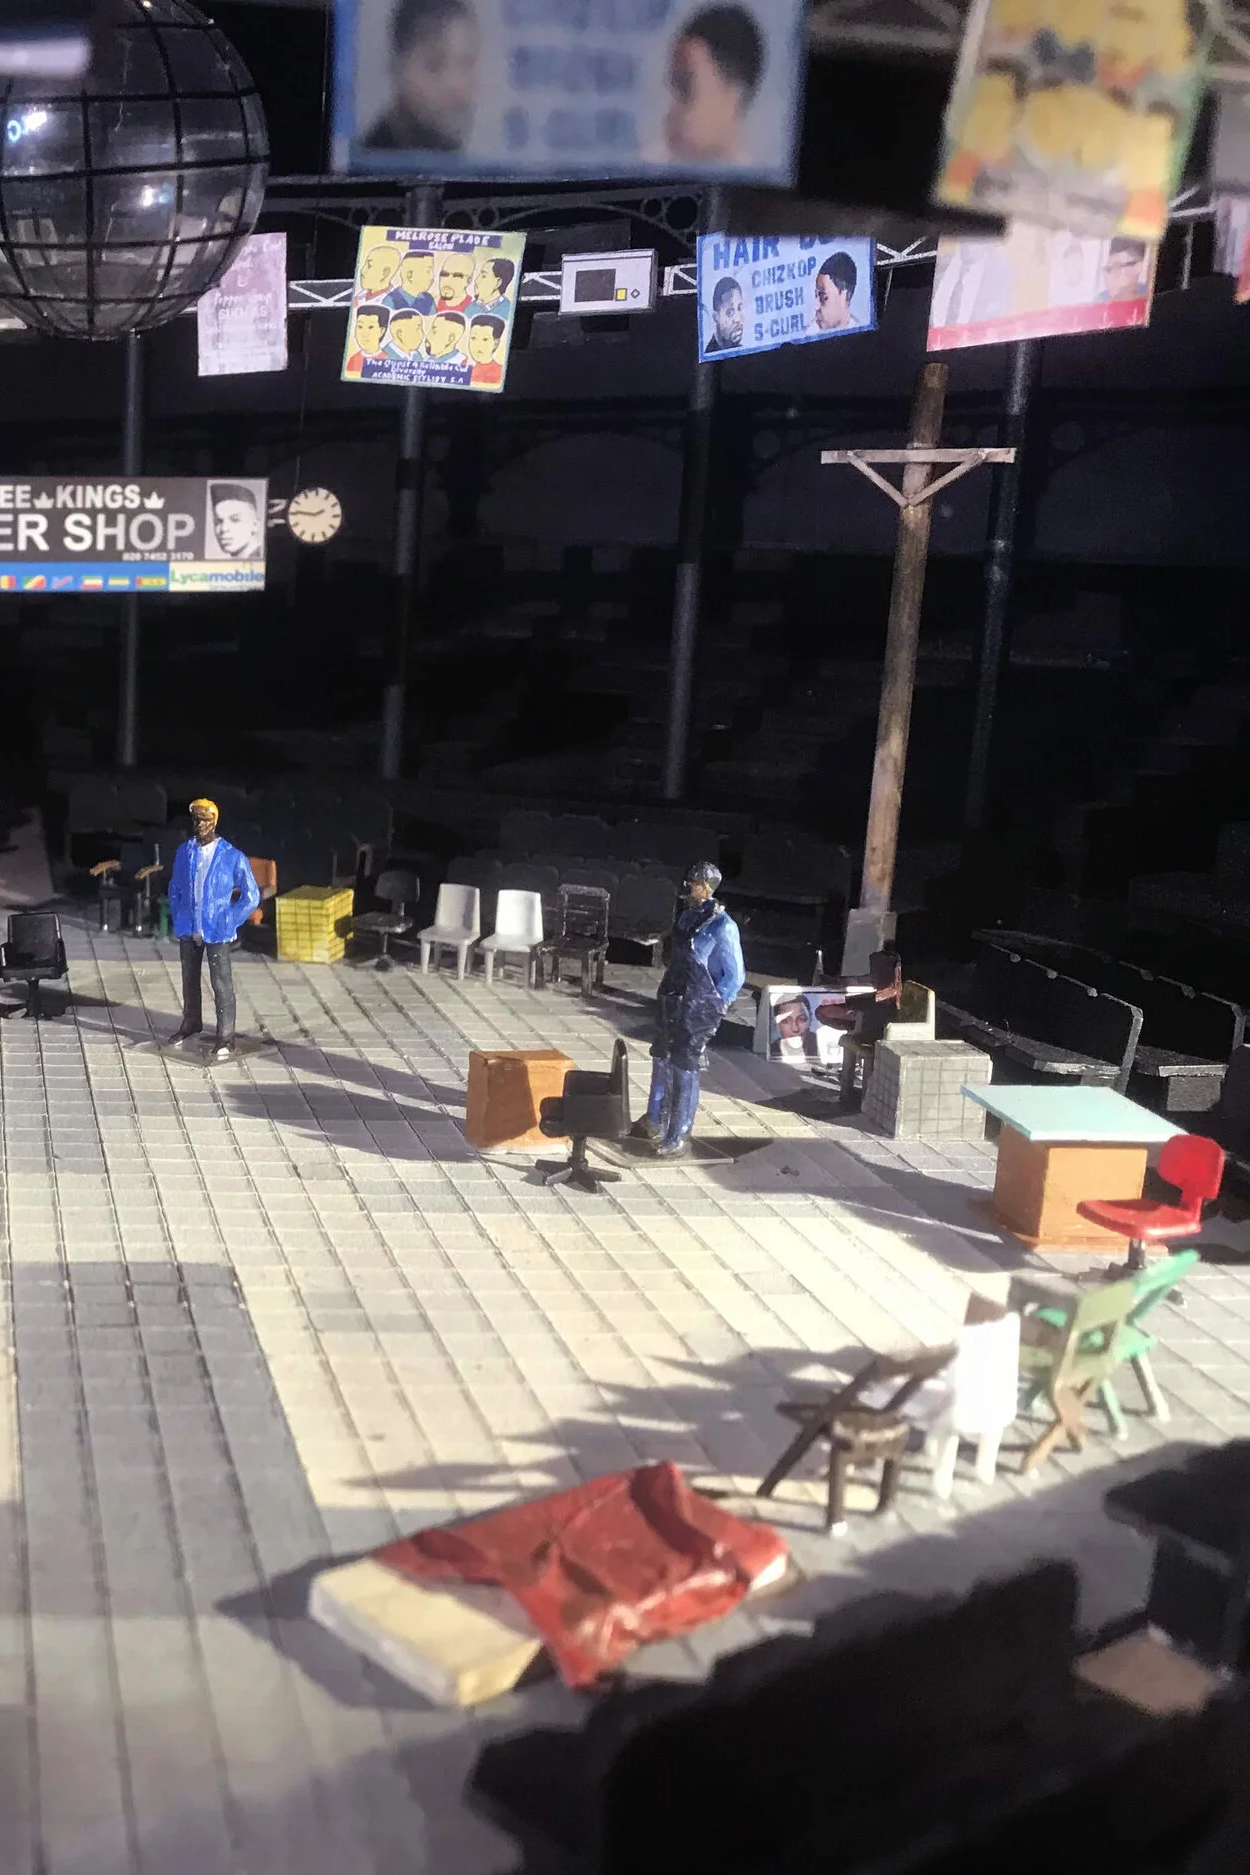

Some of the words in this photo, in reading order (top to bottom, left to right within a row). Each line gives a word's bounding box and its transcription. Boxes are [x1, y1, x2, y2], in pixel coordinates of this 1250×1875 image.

[395, 230, 447, 243] MELROSE
[713, 236, 780, 272] HAIR
[751, 255, 817, 290] CHIZKOP
[755, 286, 804, 316] BRUSH
[753, 312, 808, 342] S-CURL
[372, 371, 410, 381] ACADEMIC
[56, 484, 141, 510] KINGS
[62, 511, 197, 552] SHOP
[170, 567, 265, 584] Lycamobile
